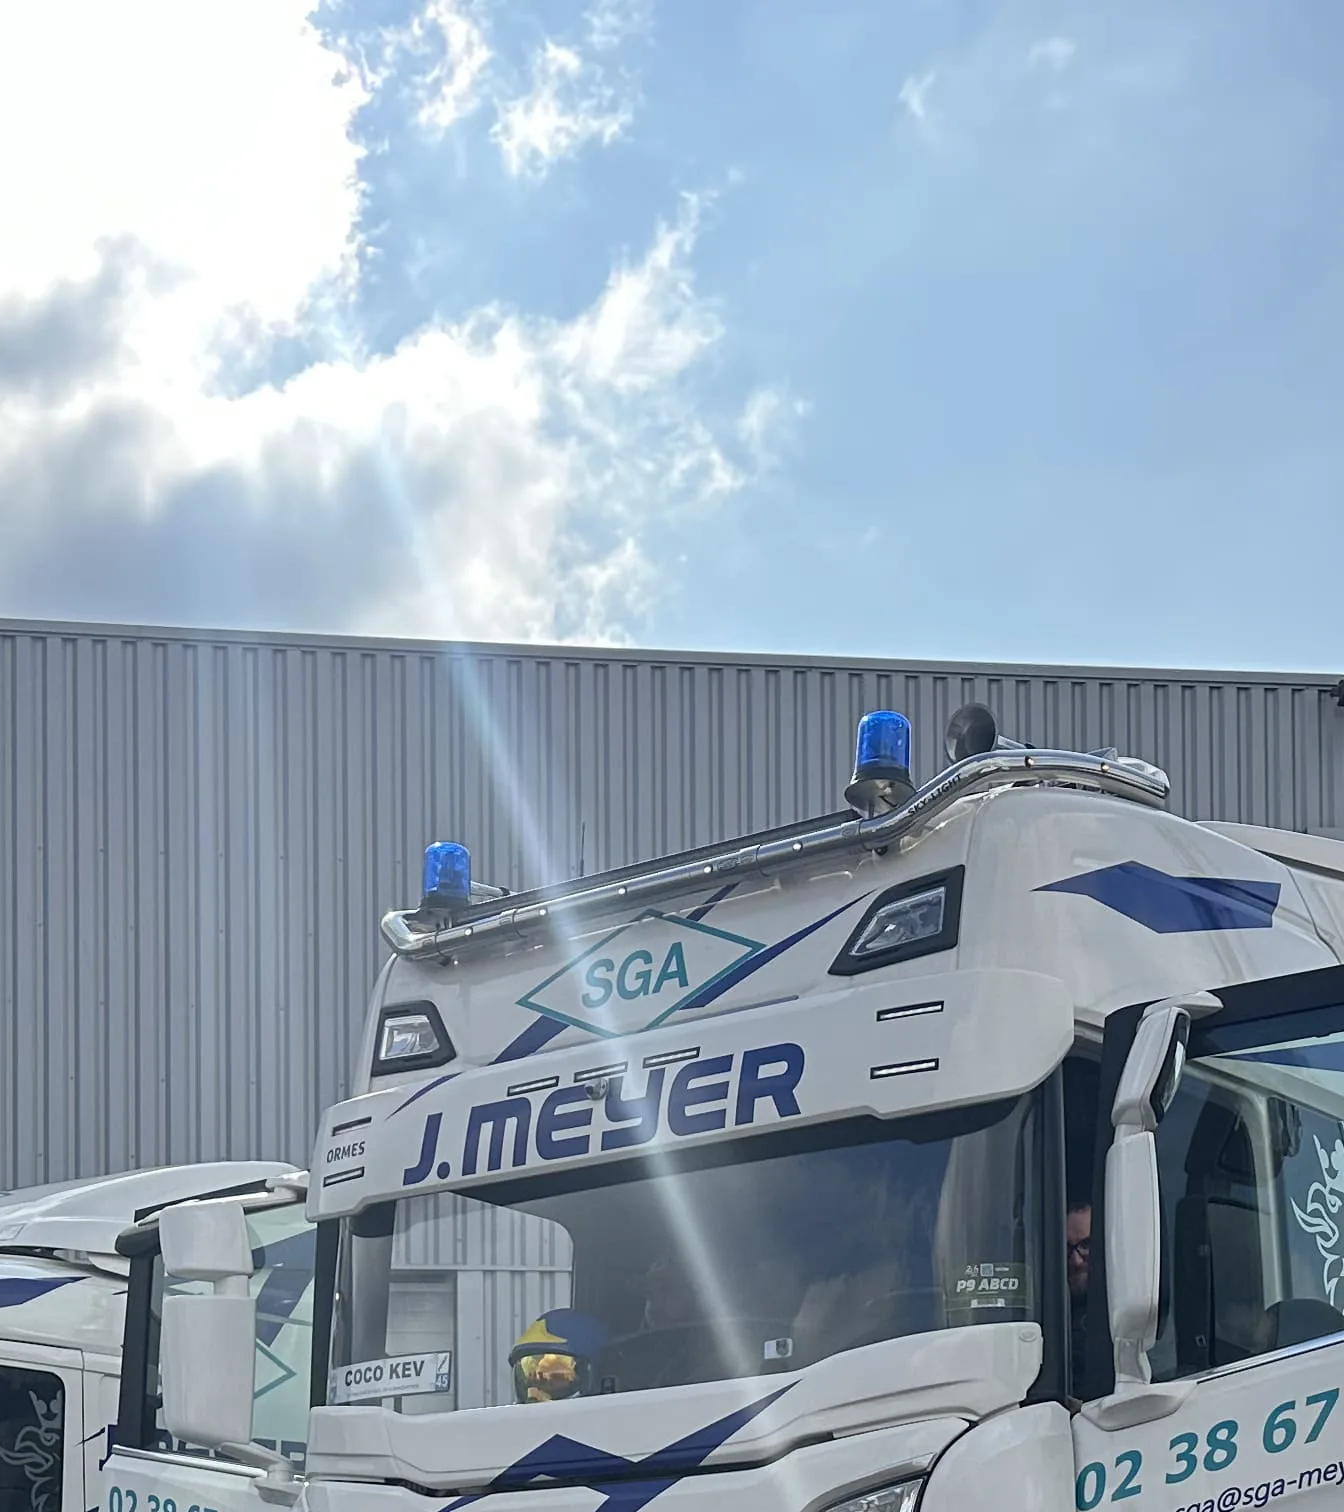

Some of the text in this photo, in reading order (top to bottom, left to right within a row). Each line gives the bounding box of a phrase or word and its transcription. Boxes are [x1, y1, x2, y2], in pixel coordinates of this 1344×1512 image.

[581, 942, 690, 1009] SGA
[403, 1042, 805, 1186] J.MEYER
[326, 1141, 366, 1163] ORMES
[978, 1278, 1019, 1291] ABCD
[345, 1360, 425, 1386] COCO KEV
[435, 1376, 448, 1387] 45
[1076, 1450, 1143, 1511] 02
[1164, 1420, 1238, 1485] 38
[1262, 1388, 1341, 1454] 67
